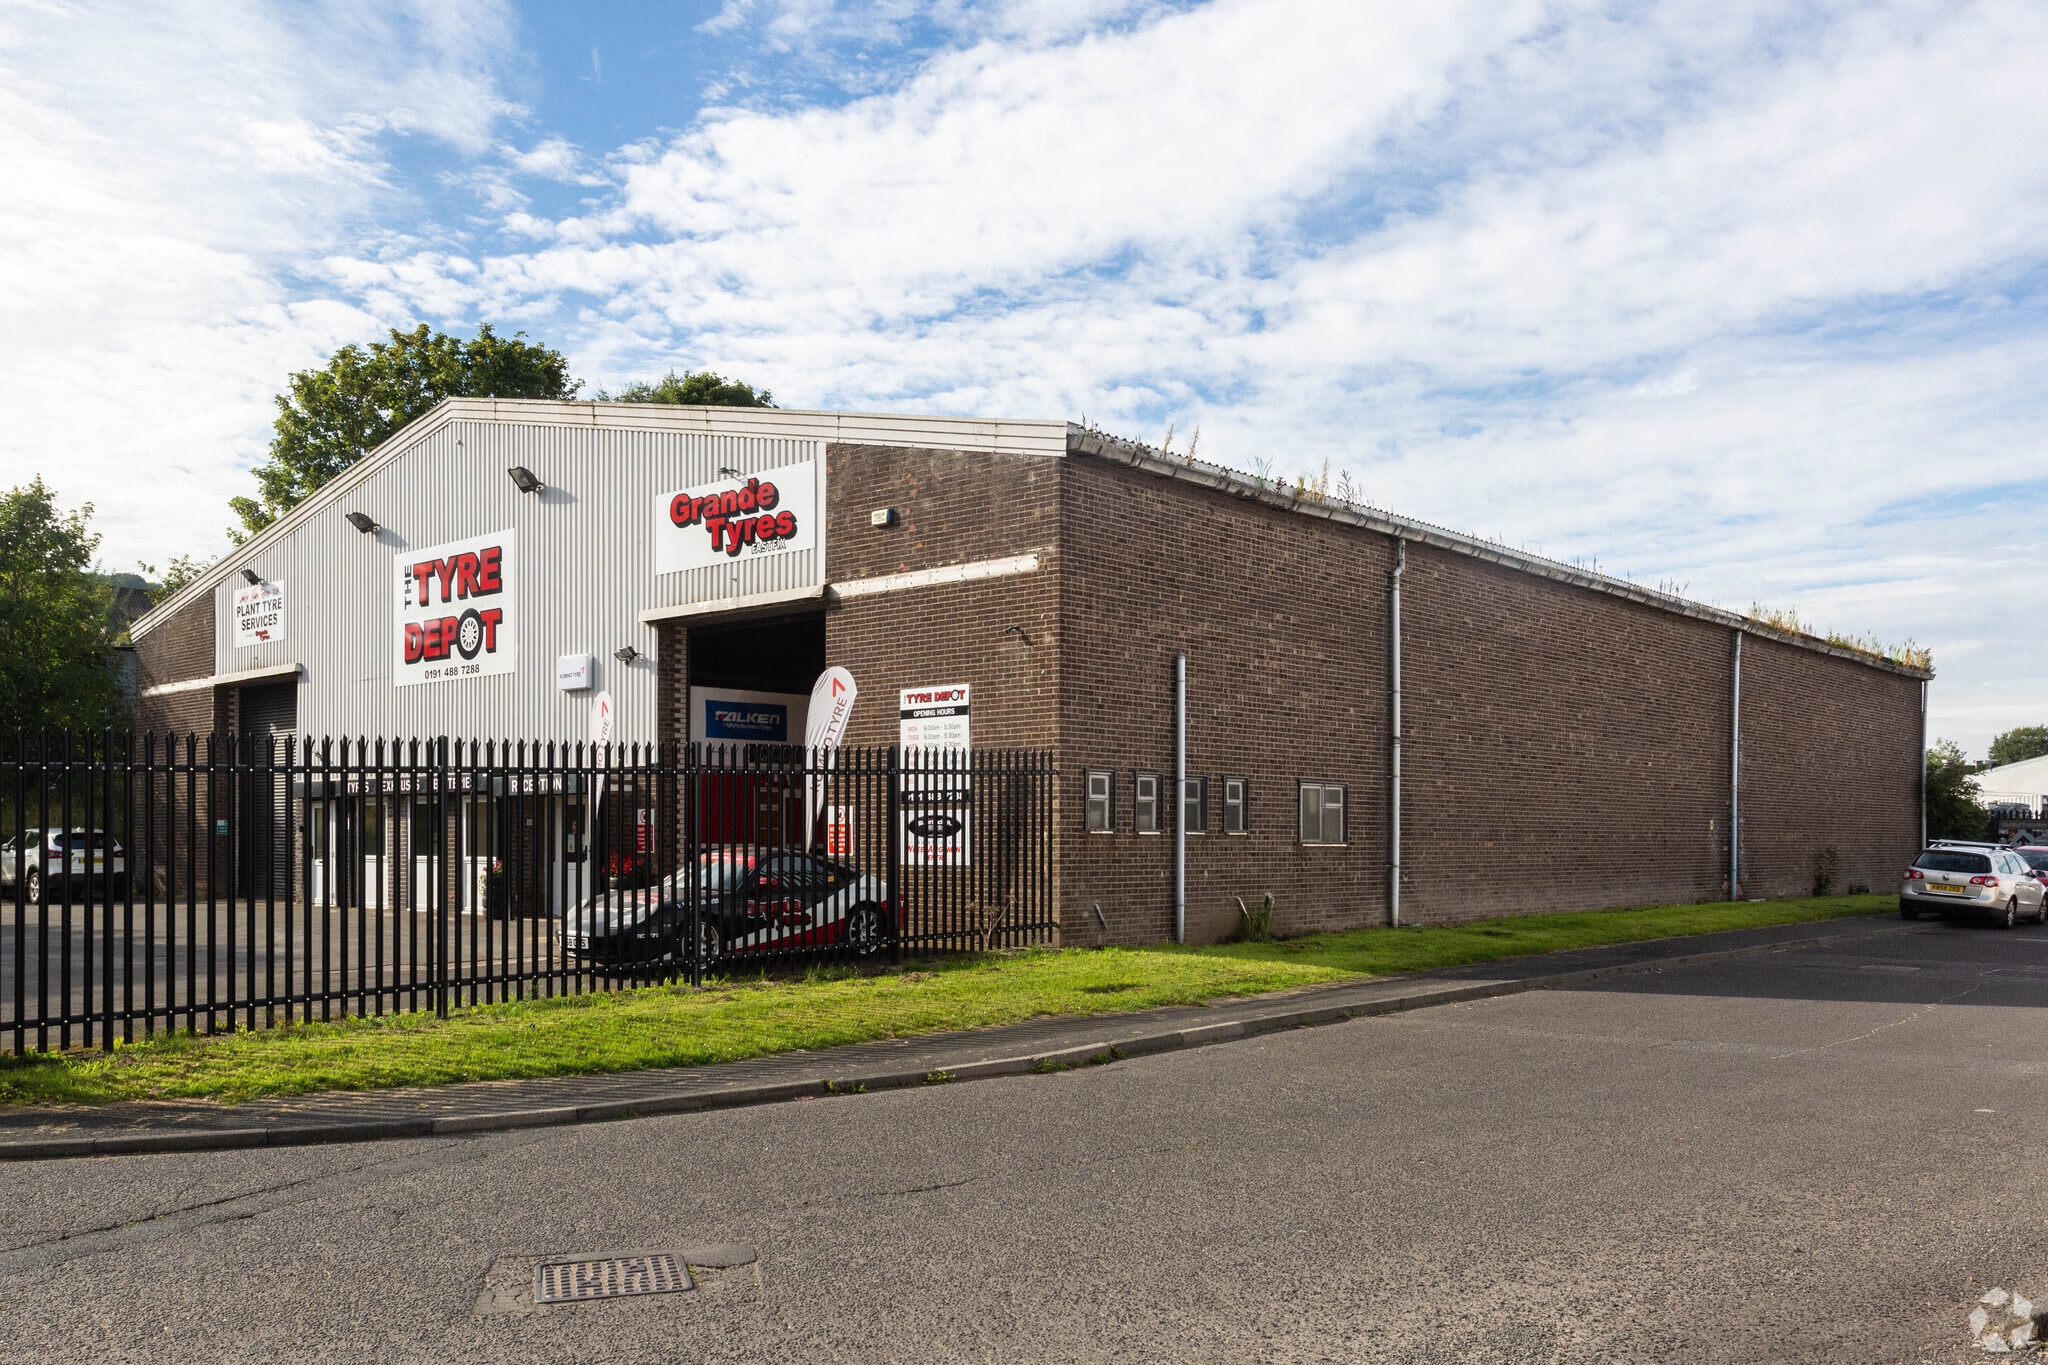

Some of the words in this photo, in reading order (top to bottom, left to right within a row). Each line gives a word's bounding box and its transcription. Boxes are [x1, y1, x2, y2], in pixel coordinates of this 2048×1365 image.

[670, 478, 779, 528] Grande
[705, 510, 798, 557] Tyres
[413, 545, 502, 607] TYRE
[404, 564, 412, 610] THE
[236, 602, 261, 618] PLANT
[262, 598, 282, 612] TYRE
[241, 613, 278, 631] SERVICES
[404, 608, 503, 665] DEPOT
[424, 669, 441, 679] 0191
[444, 667, 459, 677] 488
[461, 664, 480, 675] 7288
[907, 692, 932, 704] TYRE
[934, 690, 965, 702] DEPOT
[715, 710, 781, 725] FALKEN
[827, 697, 848, 734] TYRE
[913, 710, 936, 718] OPENING
[937, 708, 955, 716] HOURS
[511, 777, 562, 793] RCETIN
